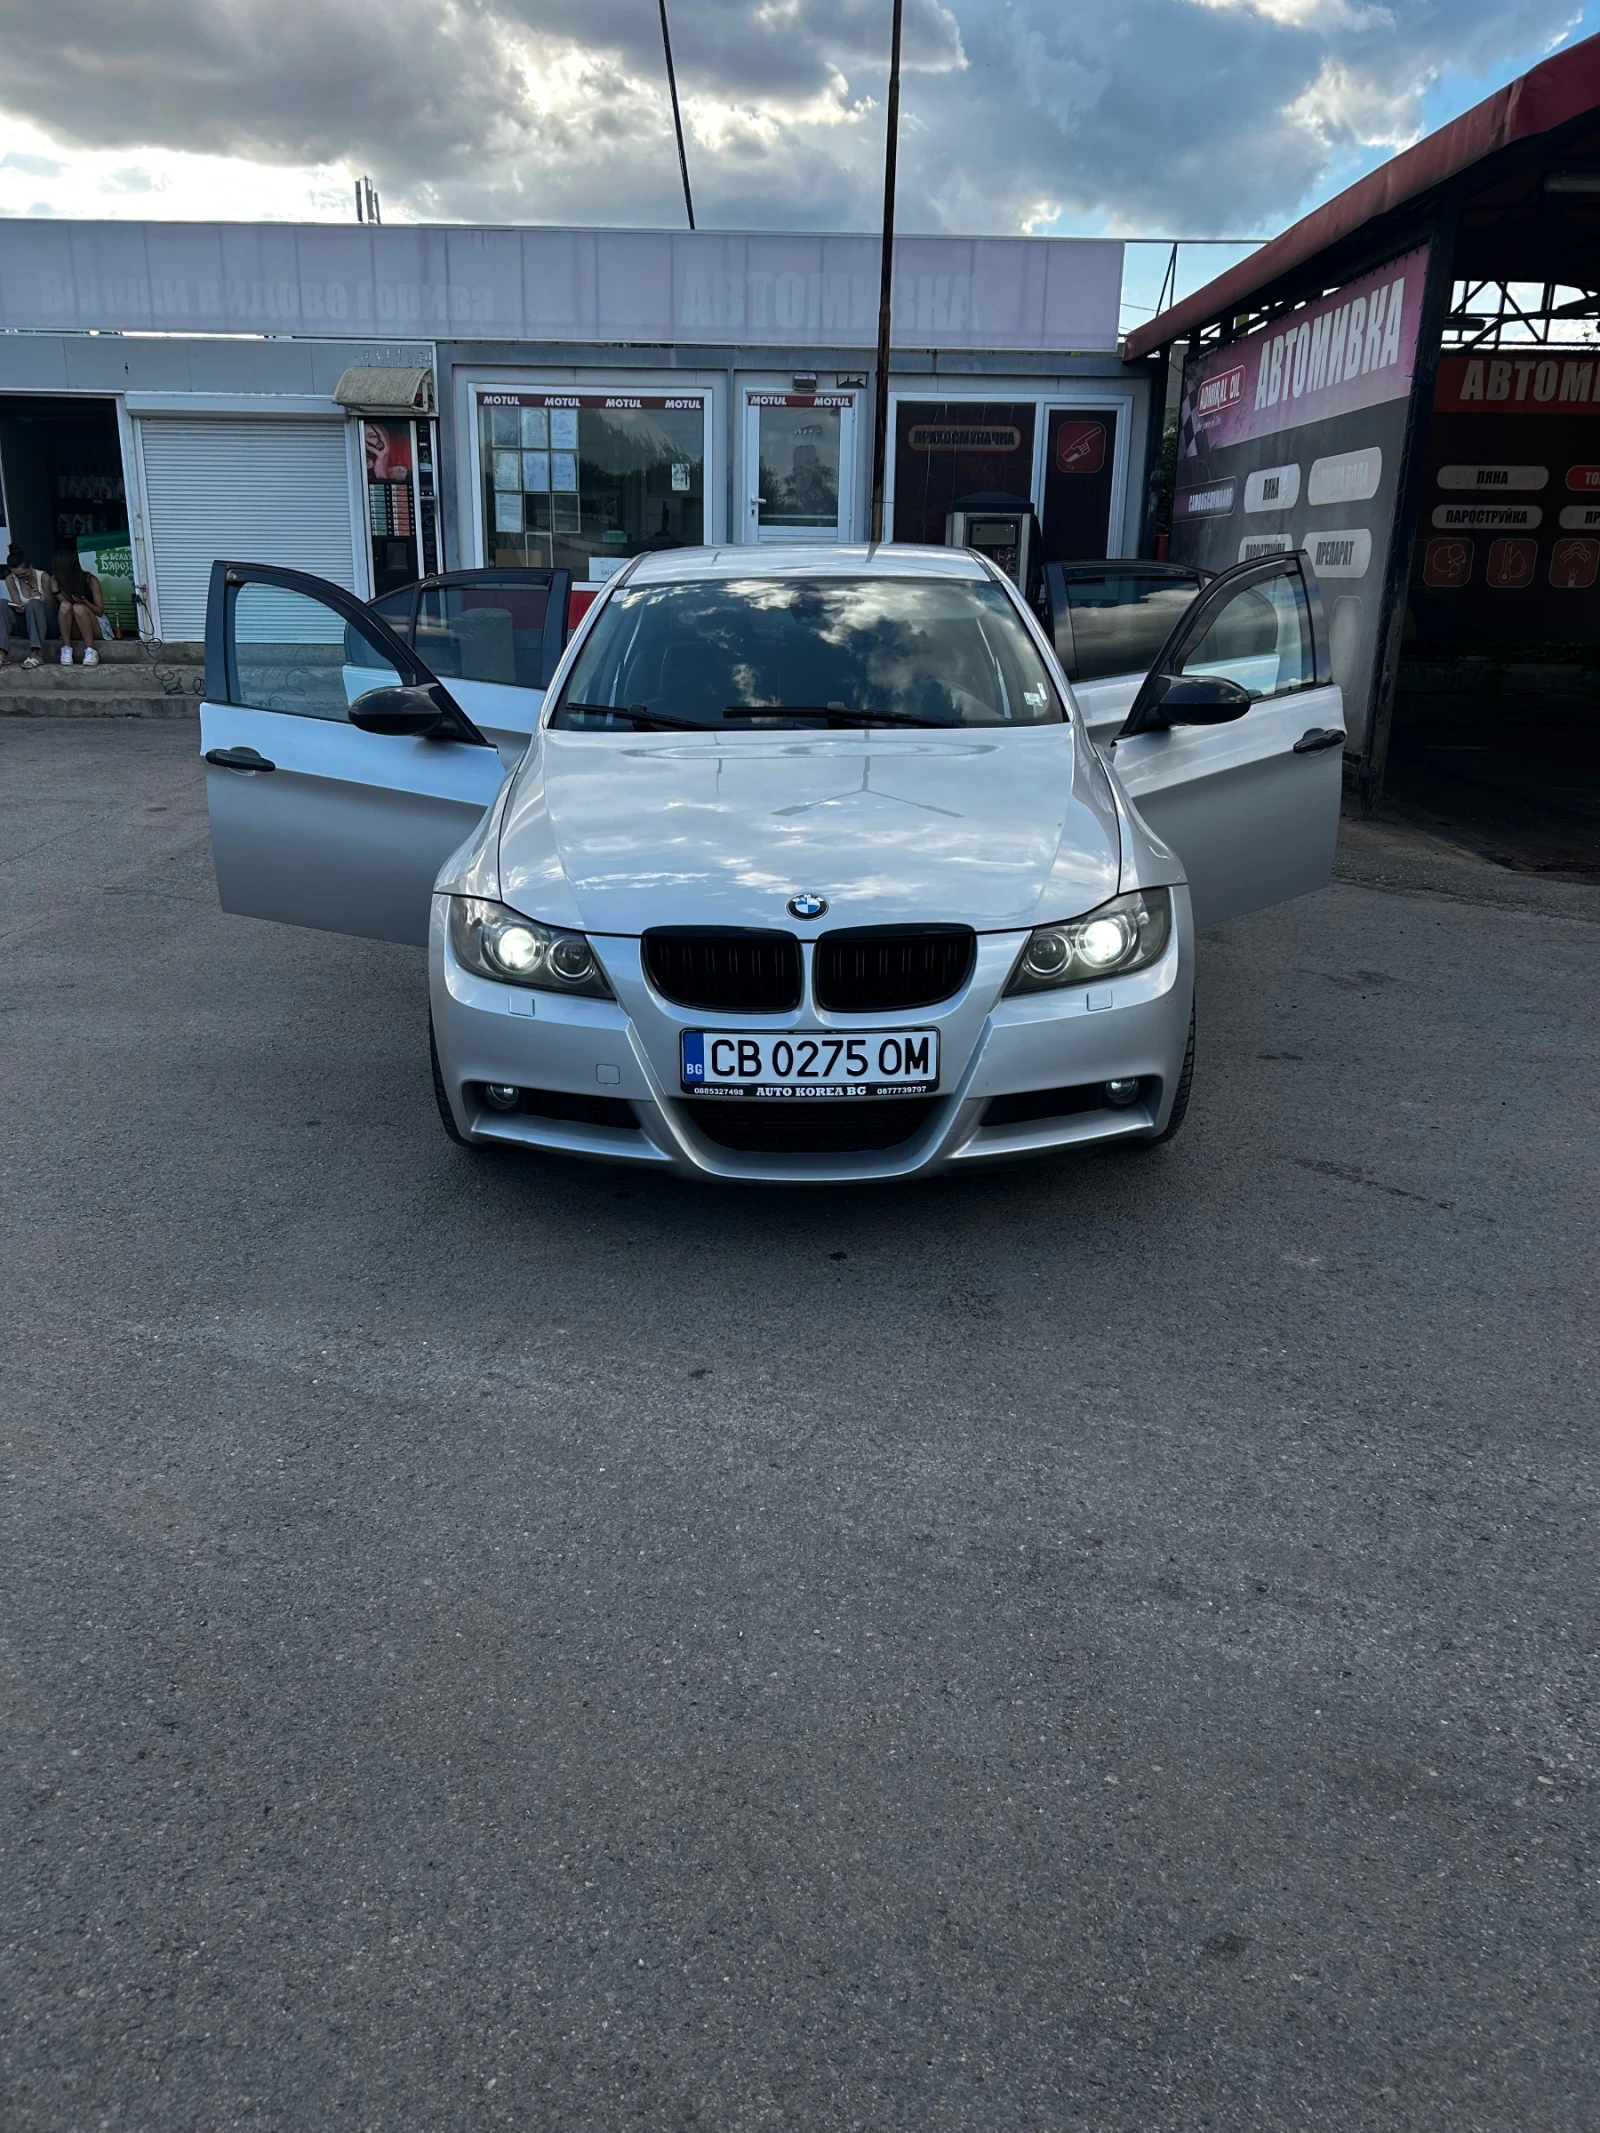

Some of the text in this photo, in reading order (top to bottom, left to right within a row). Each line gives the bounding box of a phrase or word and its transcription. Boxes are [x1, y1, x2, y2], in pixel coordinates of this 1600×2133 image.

[680, 270, 980, 331] АВТОМИВКА
[1254, 277, 1405, 411] АВТОМИВКА
[1229, 372, 1241, 399] OIL
[483, 395, 701, 409] MOTUL MOTUL MOTUL MOTUL
[750, 395, 850, 406] MOTUL MOTUL
[1476, 470, 1509, 485] ПЯНА
[1585, 471, 1600, 485] ТО
[1262, 477, 1280, 500] ПЯНА
[1445, 508, 1528, 524] ПАРОСТРУЙКА
[1316, 541, 1355, 566] ПРЕПАРАТ
[711, 1037, 929, 1077] CB 0275 OM
[686, 1063, 703, 1075] BG
[756, 1087, 792, 1096] AUTO
[795, 1087, 844, 1097] KOREA
[846, 1086, 867, 1096] BG
[876, 1085, 927, 1095] 0877739797
